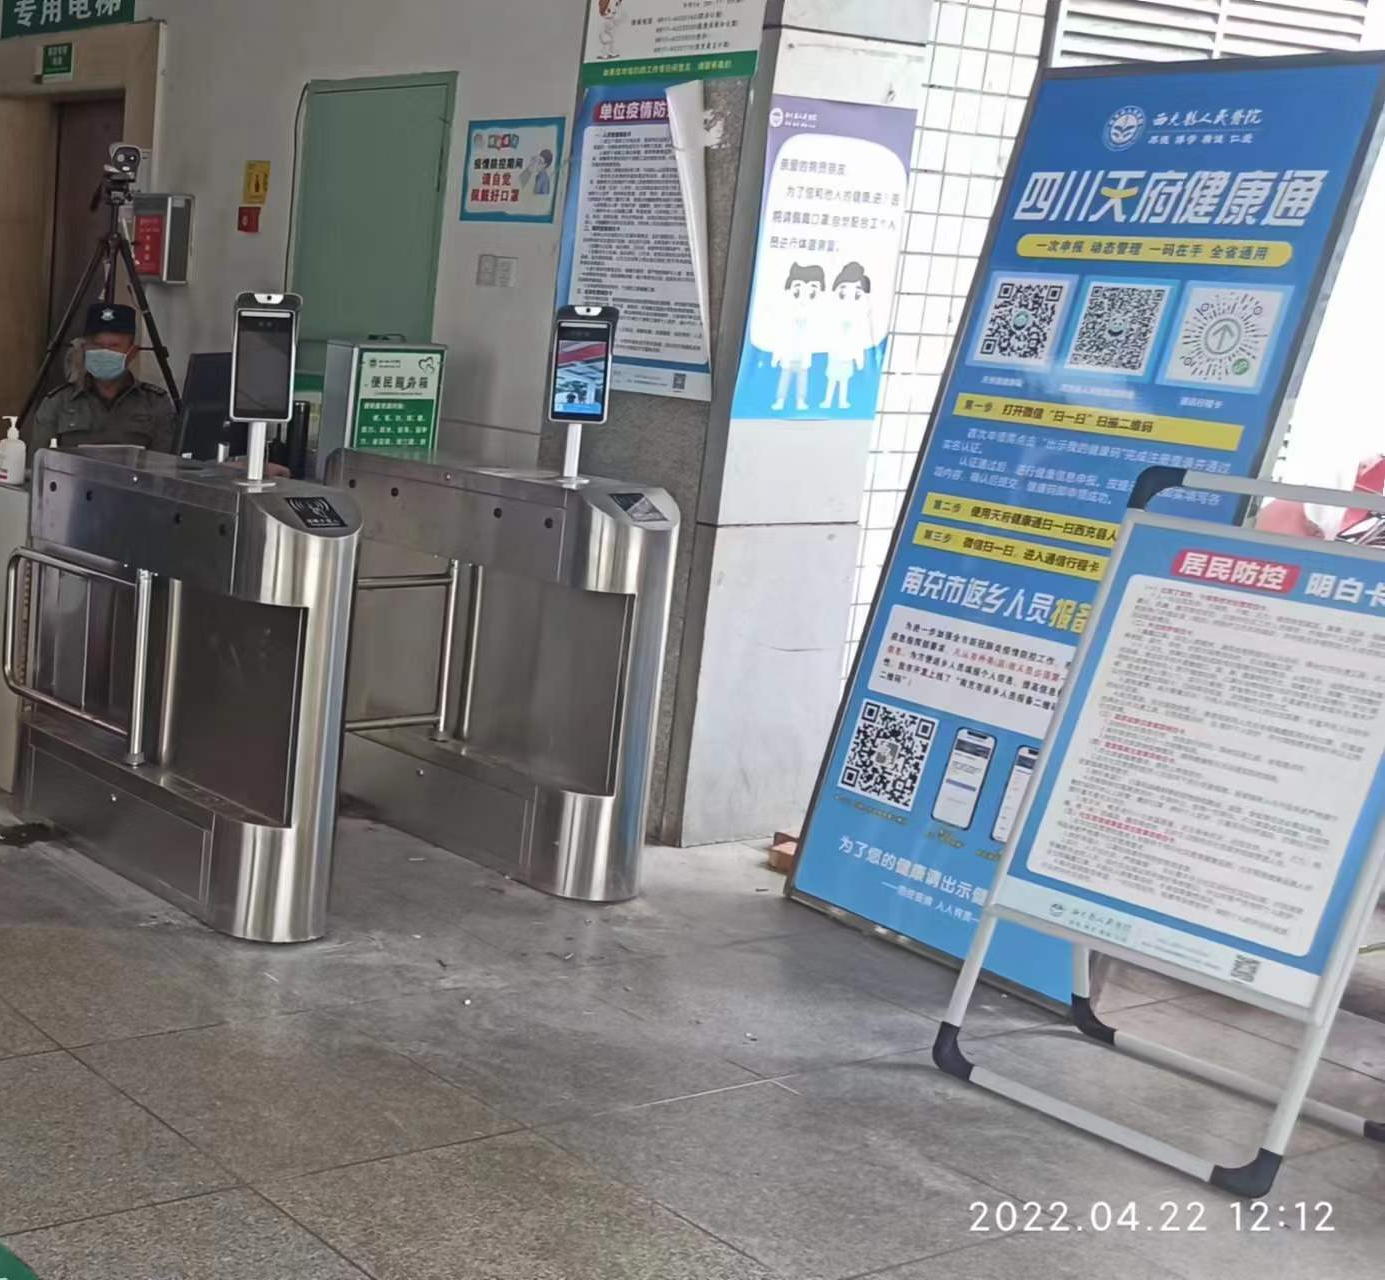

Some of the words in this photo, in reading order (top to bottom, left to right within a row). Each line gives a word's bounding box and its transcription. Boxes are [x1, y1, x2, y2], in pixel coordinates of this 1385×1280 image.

[14, 0, 121, 27] 专用电梯
[599, 100, 669, 121] 单位疫情防
[482, 172, 512, 186] 请自觉
[470, 189, 520, 202] 佩戴好口罩
[1013, 169, 1329, 226] 四川天府健康通
[1036, 240, 1084, 254] 一次申报
[1090, 240, 1143, 256] 动态管理
[1149, 243, 1204, 258] 一码在手
[1211, 245, 1268, 261] 全省通用
[964, 399, 994, 413] 第一步
[932, 499, 961, 513] 第二步
[923, 529, 952, 544] 第三步
[1178, 551, 1288, 590] 居民防控
[1303, 572, 1385, 608] 明白卡
